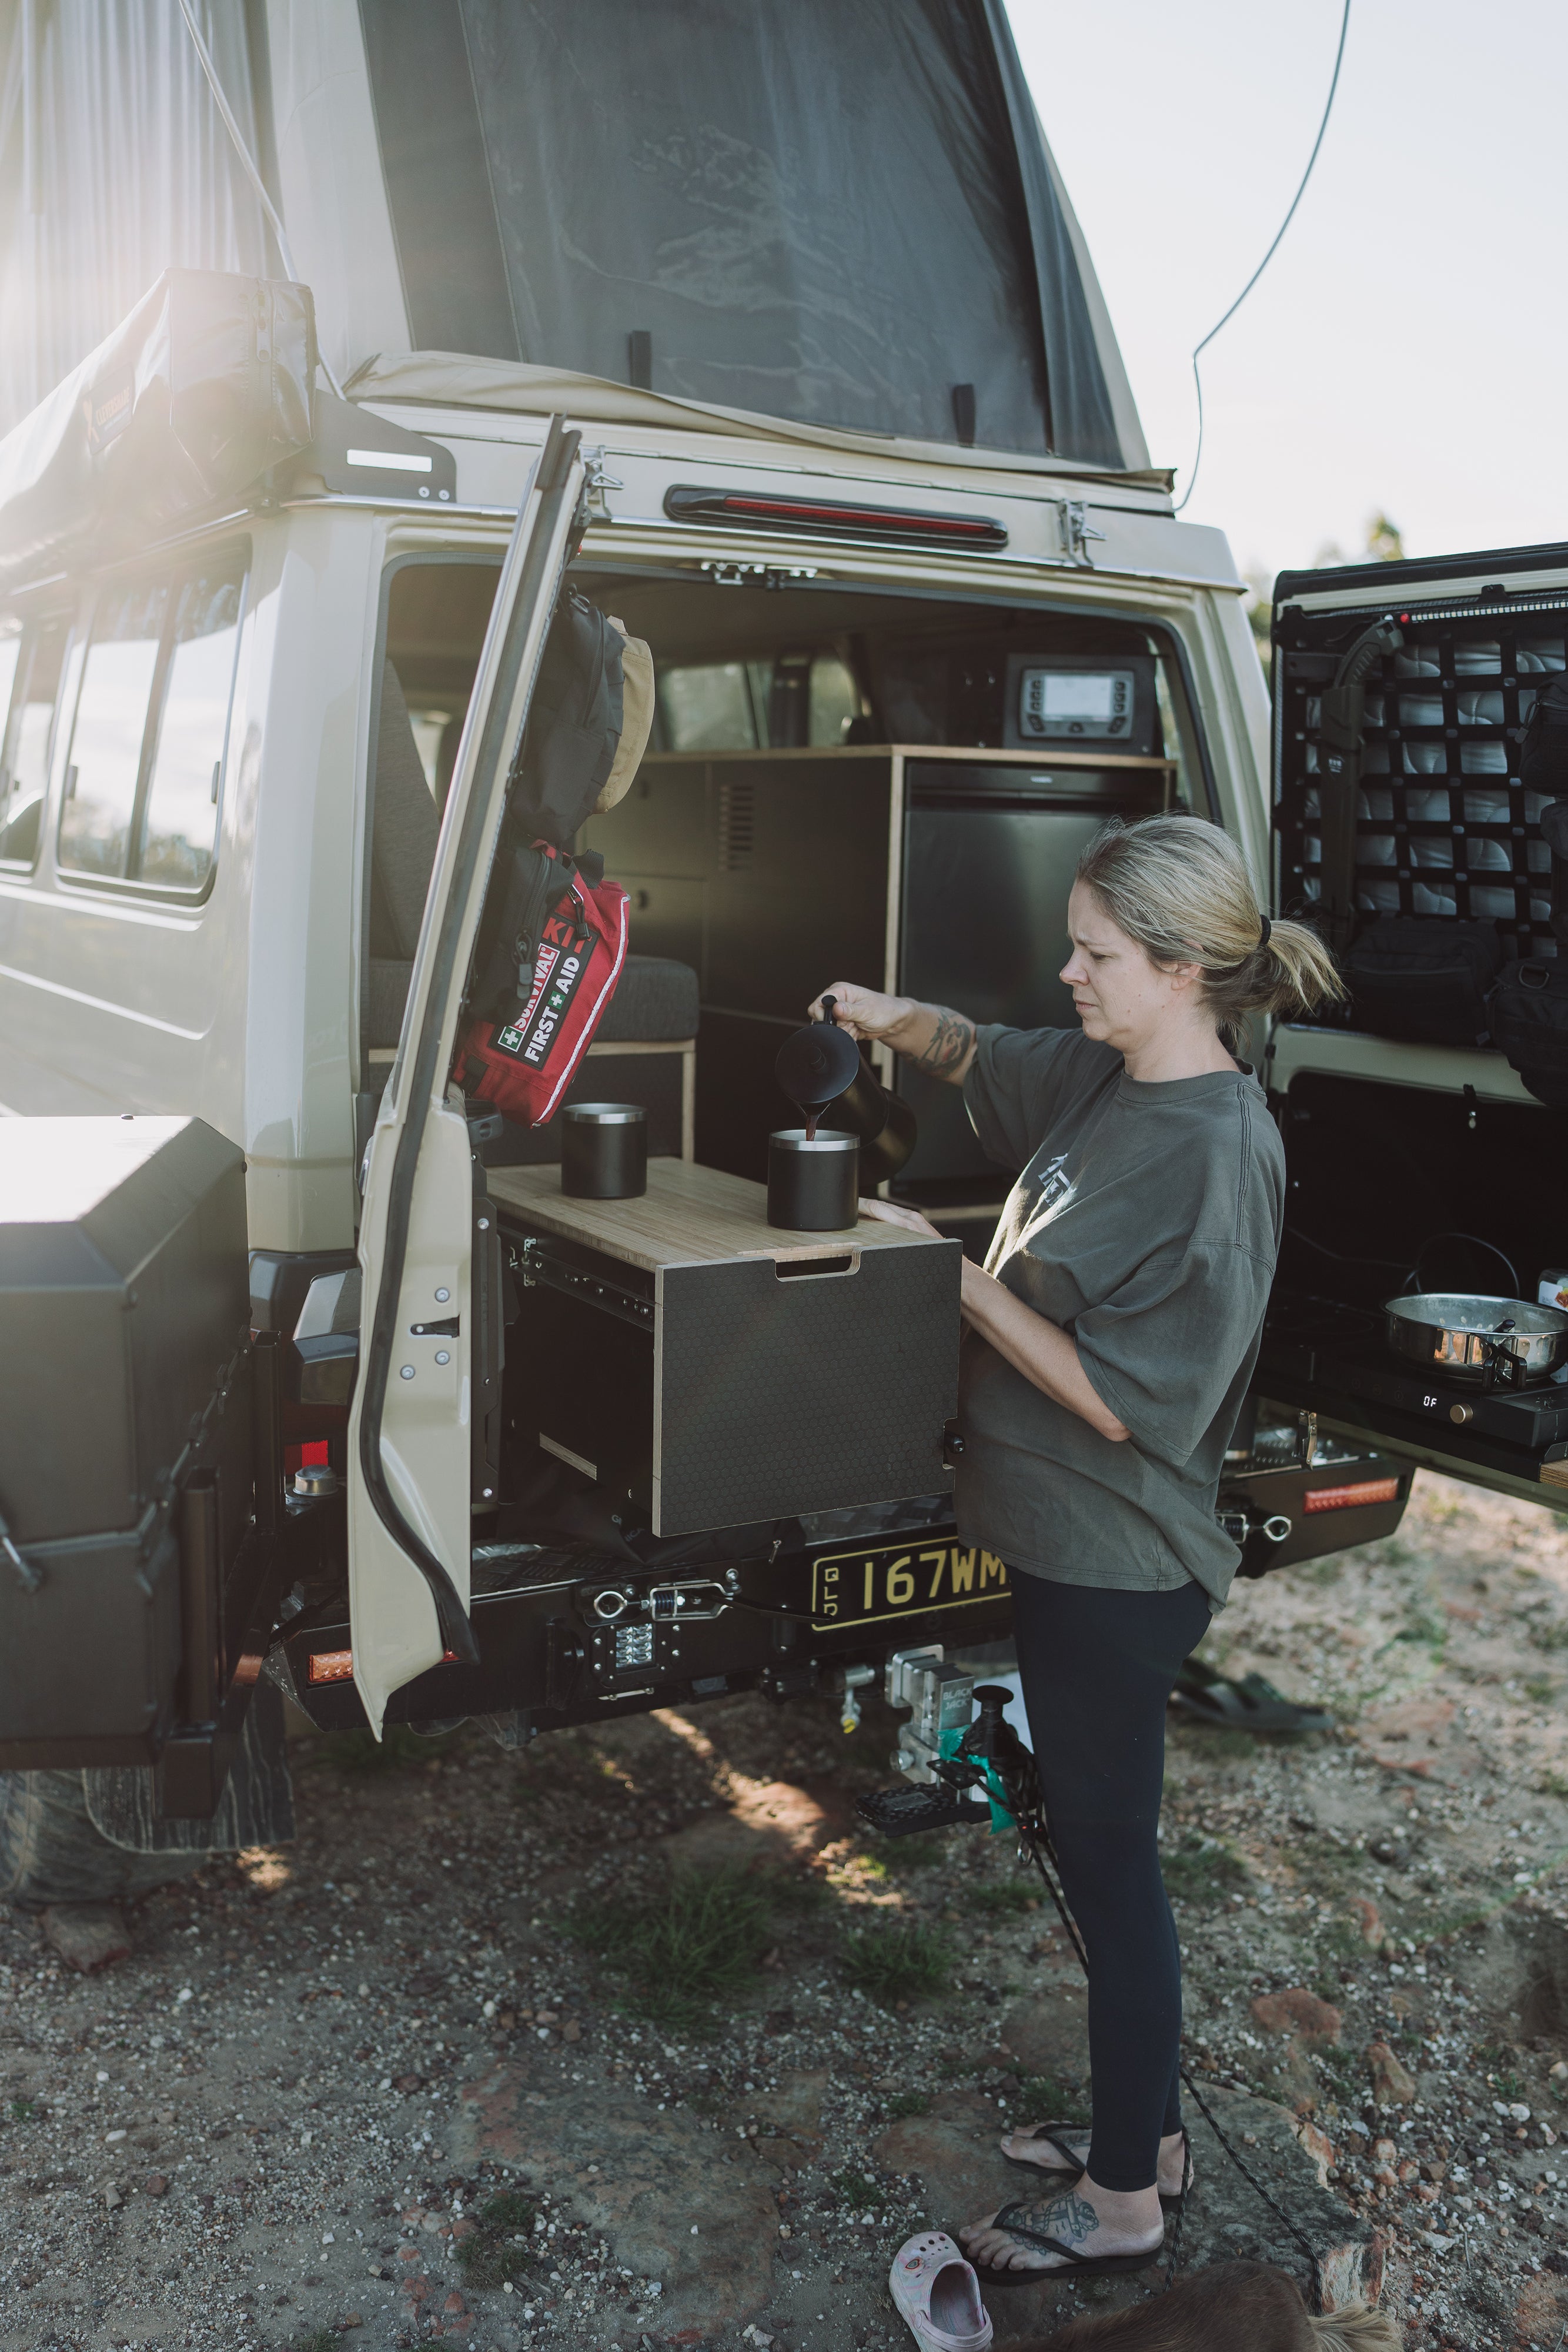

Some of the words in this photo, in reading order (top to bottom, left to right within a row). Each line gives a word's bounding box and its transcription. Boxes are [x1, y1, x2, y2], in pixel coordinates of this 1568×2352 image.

[524, 1007, 559, 1062] FIRST
[556, 957, 580, 994] AID
[864, 1548, 1007, 1609] 167WM
